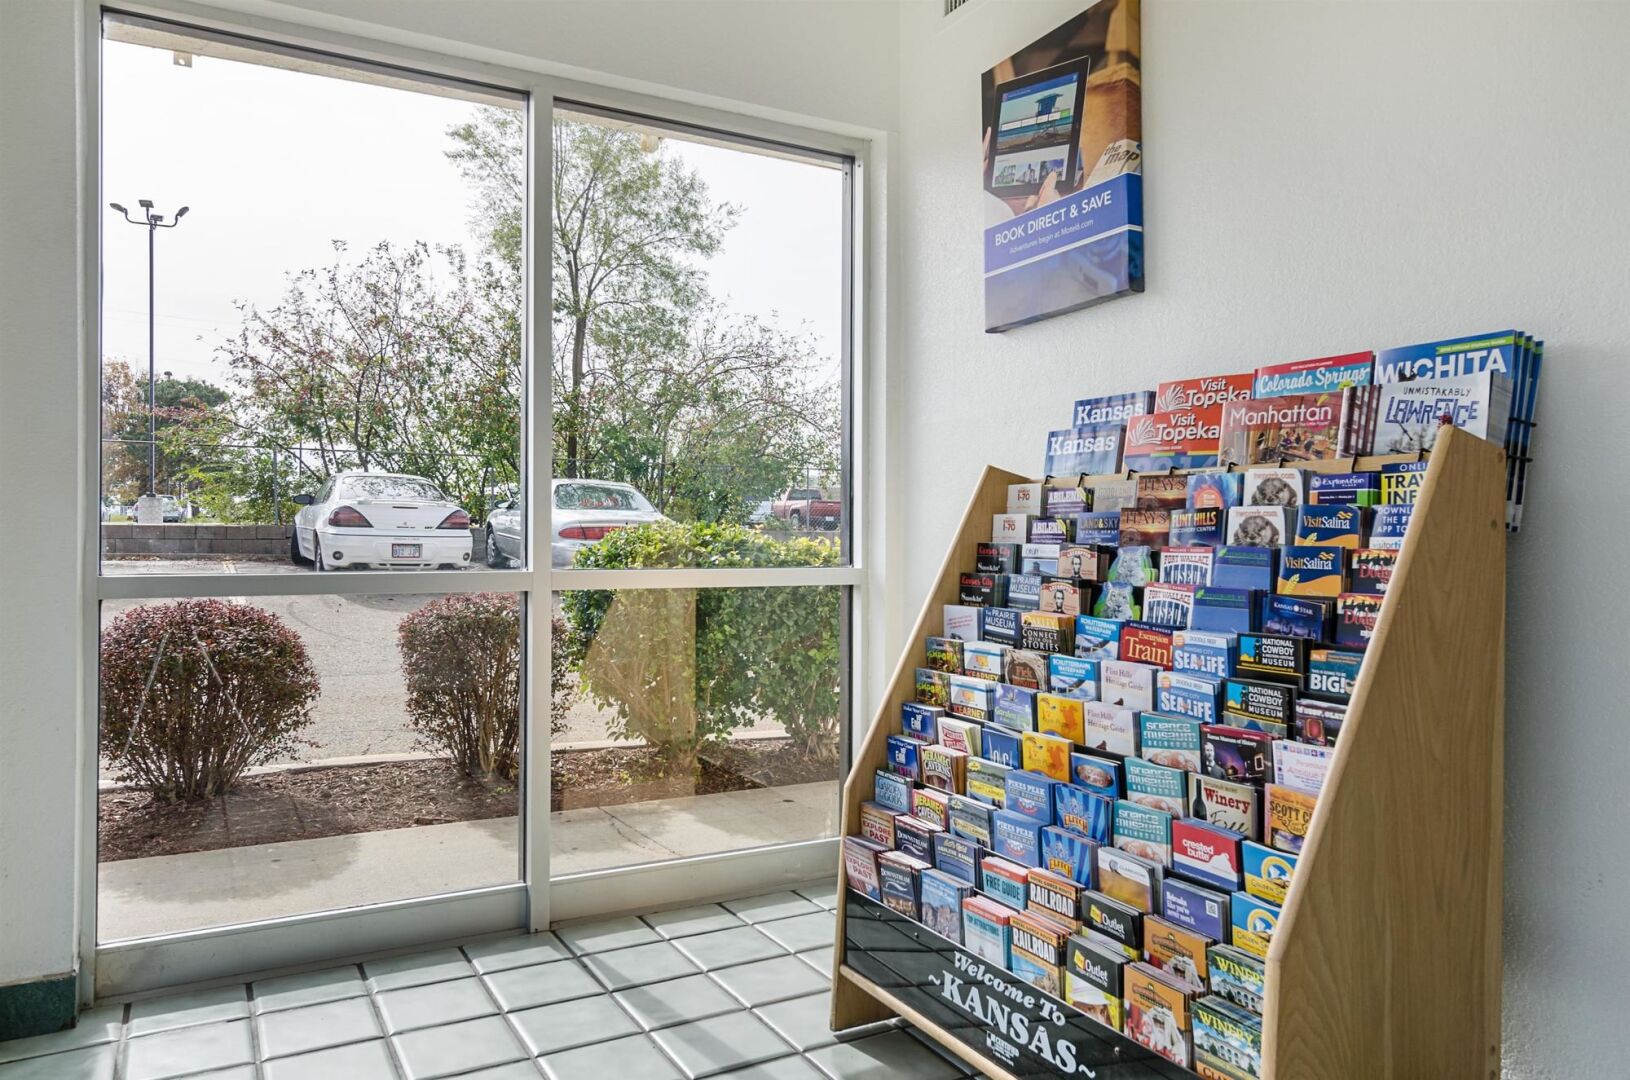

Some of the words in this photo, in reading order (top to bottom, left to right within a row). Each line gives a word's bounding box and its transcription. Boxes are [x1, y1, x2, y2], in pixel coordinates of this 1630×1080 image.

[1104, 143, 1123, 156] the
[1104, 150, 1140, 171] map
[995, 223, 1025, 246] BOOK
[1027, 208, 1067, 235] DIRECT
[1069, 204, 1079, 218] &
[1081, 190, 1112, 214] SAVE
[1009, 240, 1038, 254] Adventures
[1038, 233, 1053, 244] begin
[1377, 348, 1507, 384] WICHITA
[1200, 378, 1227, 391] Visit
[1260, 372, 1314, 393] Colorado
[1315, 366, 1370, 389] Springs
[1186, 386, 1251, 408] Topeka
[1403, 386, 1472, 397] UNMISTAKABLY
[1076, 402, 1144, 425] Kansas
[1170, 413, 1196, 426] Visit
[1229, 404, 1332, 427] Manhattan
[1156, 421, 1220, 444] Topeka
[1048, 436, 1116, 456] Kansas
[1143, 479, 1187, 490] HAYS
[1017, 493, 1031, 501] I-70
[1126, 510, 1168, 524] HAYS
[1171, 513, 1193, 527] FLINT
[1193, 511, 1217, 526] HILLS
[1382, 516, 1398, 524] THE
[1002, 523, 1016, 532] I-70
[1377, 525, 1392, 534] APP
[1285, 556, 1332, 570] VisitSalina
[1016, 575, 1041, 586] PRAIRIE
[1163, 564, 1208, 585] MUSEUM
[1009, 583, 1041, 594] MUSEUM
[992, 609, 1016, 620] PRAIRIE
[1147, 600, 1189, 627] MUSEUM
[1299, 606, 1314, 615] STAR
[985, 616, 1016, 629] MUSEUM
[1022, 628, 1058, 639] CONNECT
[1138, 630, 1169, 644] Excursion
[1022, 639, 1060, 652] STORIES
[1262, 638, 1294, 648] NATIONAL
[1262, 645, 1294, 656] COWBOY
[1125, 636, 1173, 666] Train!
[1174, 650, 1198, 671] SEA
[1262, 657, 1295, 667] MUSEUM
[967, 671, 999, 681] KEARNEY
[1119, 669, 1132, 678] Hills
[1310, 673, 1346, 693] BIG!
[1248, 685, 1283, 698] NATIONAL
[1161, 691, 1185, 713] SEA
[1248, 693, 1283, 706] COWBOY
[953, 703, 985, 719] KEARNEY
[1101, 711, 1115, 721] Hills
[1248, 705, 1284, 718] MUSEUM
[1146, 721, 1191, 732] science
[1143, 730, 1196, 741] museum
[924, 760, 951, 776] CAVERNS
[1130, 766, 1173, 779] science
[1008, 779, 1027, 789] PIKES
[1027, 783, 1046, 795] PEAK
[1128, 775, 1178, 790] museum
[1204, 787, 1251, 814] Winery
[1118, 809, 1159, 825] science
[1270, 800, 1301, 820] SCOTT
[863, 820, 892, 836] EXPLORE
[1116, 817, 1164, 836] museum
[1210, 810, 1249, 834] Free
[869, 830, 889, 843] PAST
[1016, 825, 1034, 837] PEAK
[1182, 838, 1214, 855] crested
[1187, 848, 1210, 861] butte
[846, 855, 873, 871] EXPLORE
[853, 865, 873, 880] PAST
[985, 873, 1001, 889] FREE
[1001, 881, 1021, 901] GUIDE
[1030, 883, 1074, 918] RAILROAD
[1101, 913, 1125, 935] Outlet
[1012, 927, 1055, 964] RAILROAD
[1084, 959, 1108, 980] Outlet
[954, 950, 1035, 1008] Welcome
[1039, 997, 1066, 1027] To
[1197, 1008, 1254, 1046] WINERY
